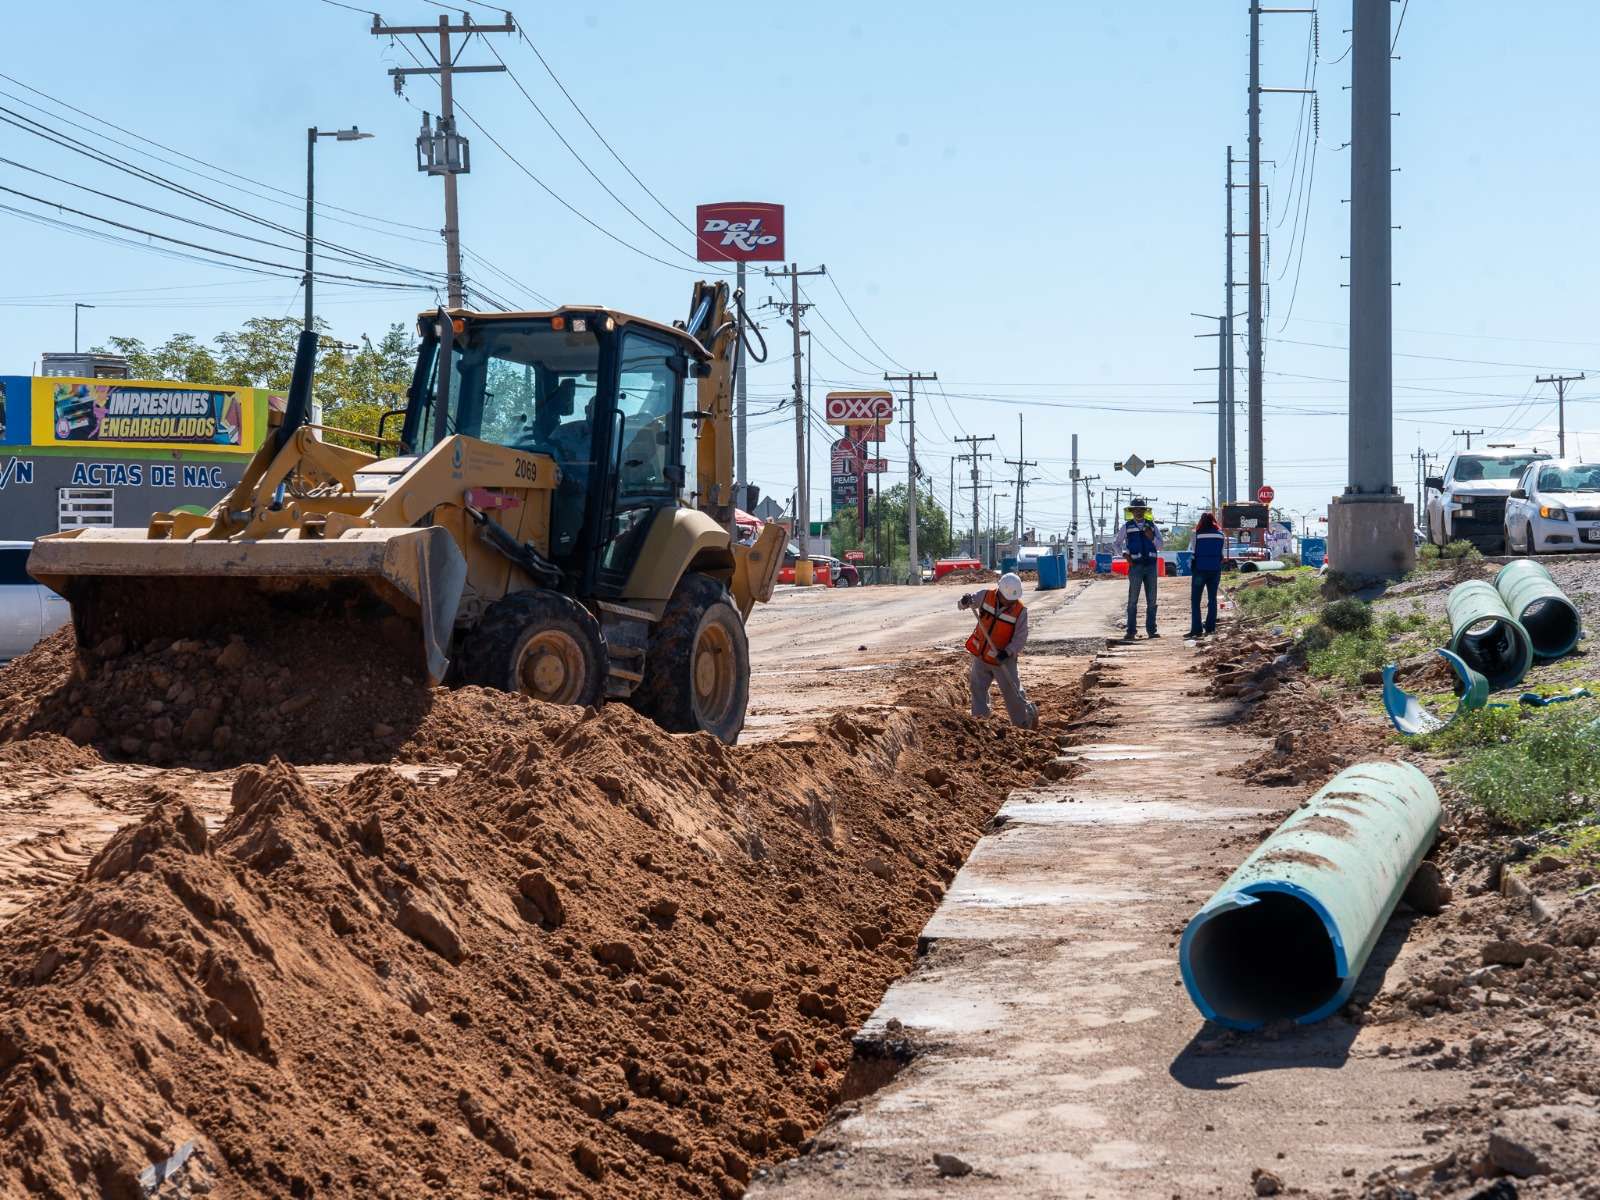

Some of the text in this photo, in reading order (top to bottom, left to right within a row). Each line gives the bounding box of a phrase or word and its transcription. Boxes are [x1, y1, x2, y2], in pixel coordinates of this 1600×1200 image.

[703, 218, 761, 232] Del
[719, 231, 777, 251] Rio
[109, 392, 209, 415] IMPRESIONES
[828, 397, 891, 419] OXXO
[99, 418, 215, 437] ENGARGOLADOS
[71, 463, 227, 489] ACTAS DE NAC.
[515, 458, 537, 482] 2069
